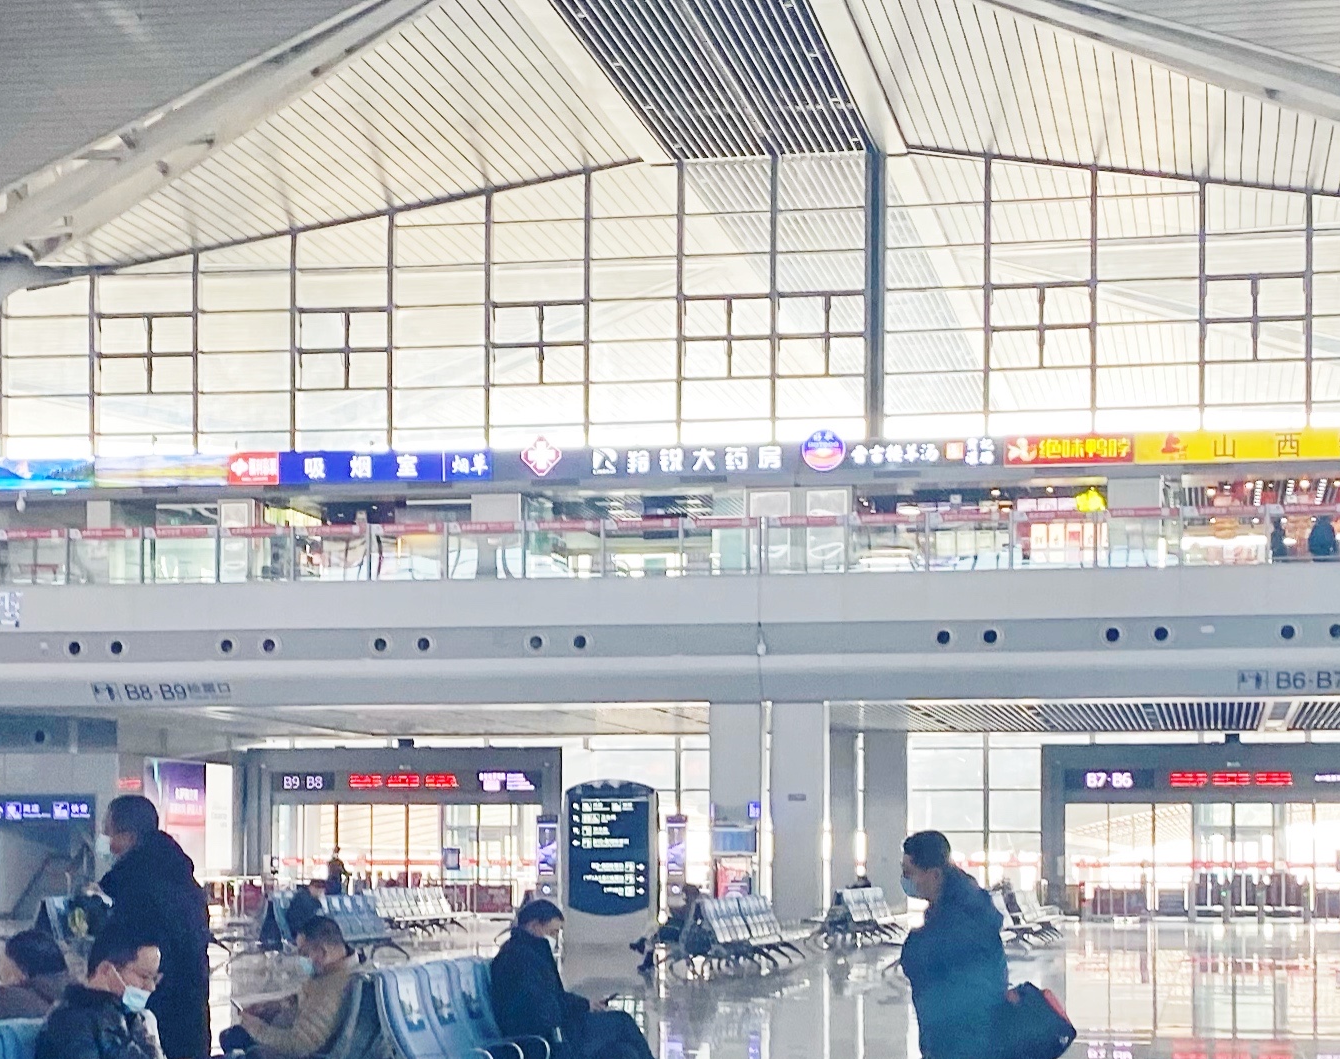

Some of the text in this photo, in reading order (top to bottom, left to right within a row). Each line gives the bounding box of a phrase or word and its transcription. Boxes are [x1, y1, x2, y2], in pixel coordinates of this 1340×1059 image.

[626, 446, 782, 473] 羚锐大药房
[1038, 435, 1131, 460] 绝味鸭脖
[302, 454, 419, 481] 吸烟室
[450, 452, 489, 477] 烟草
